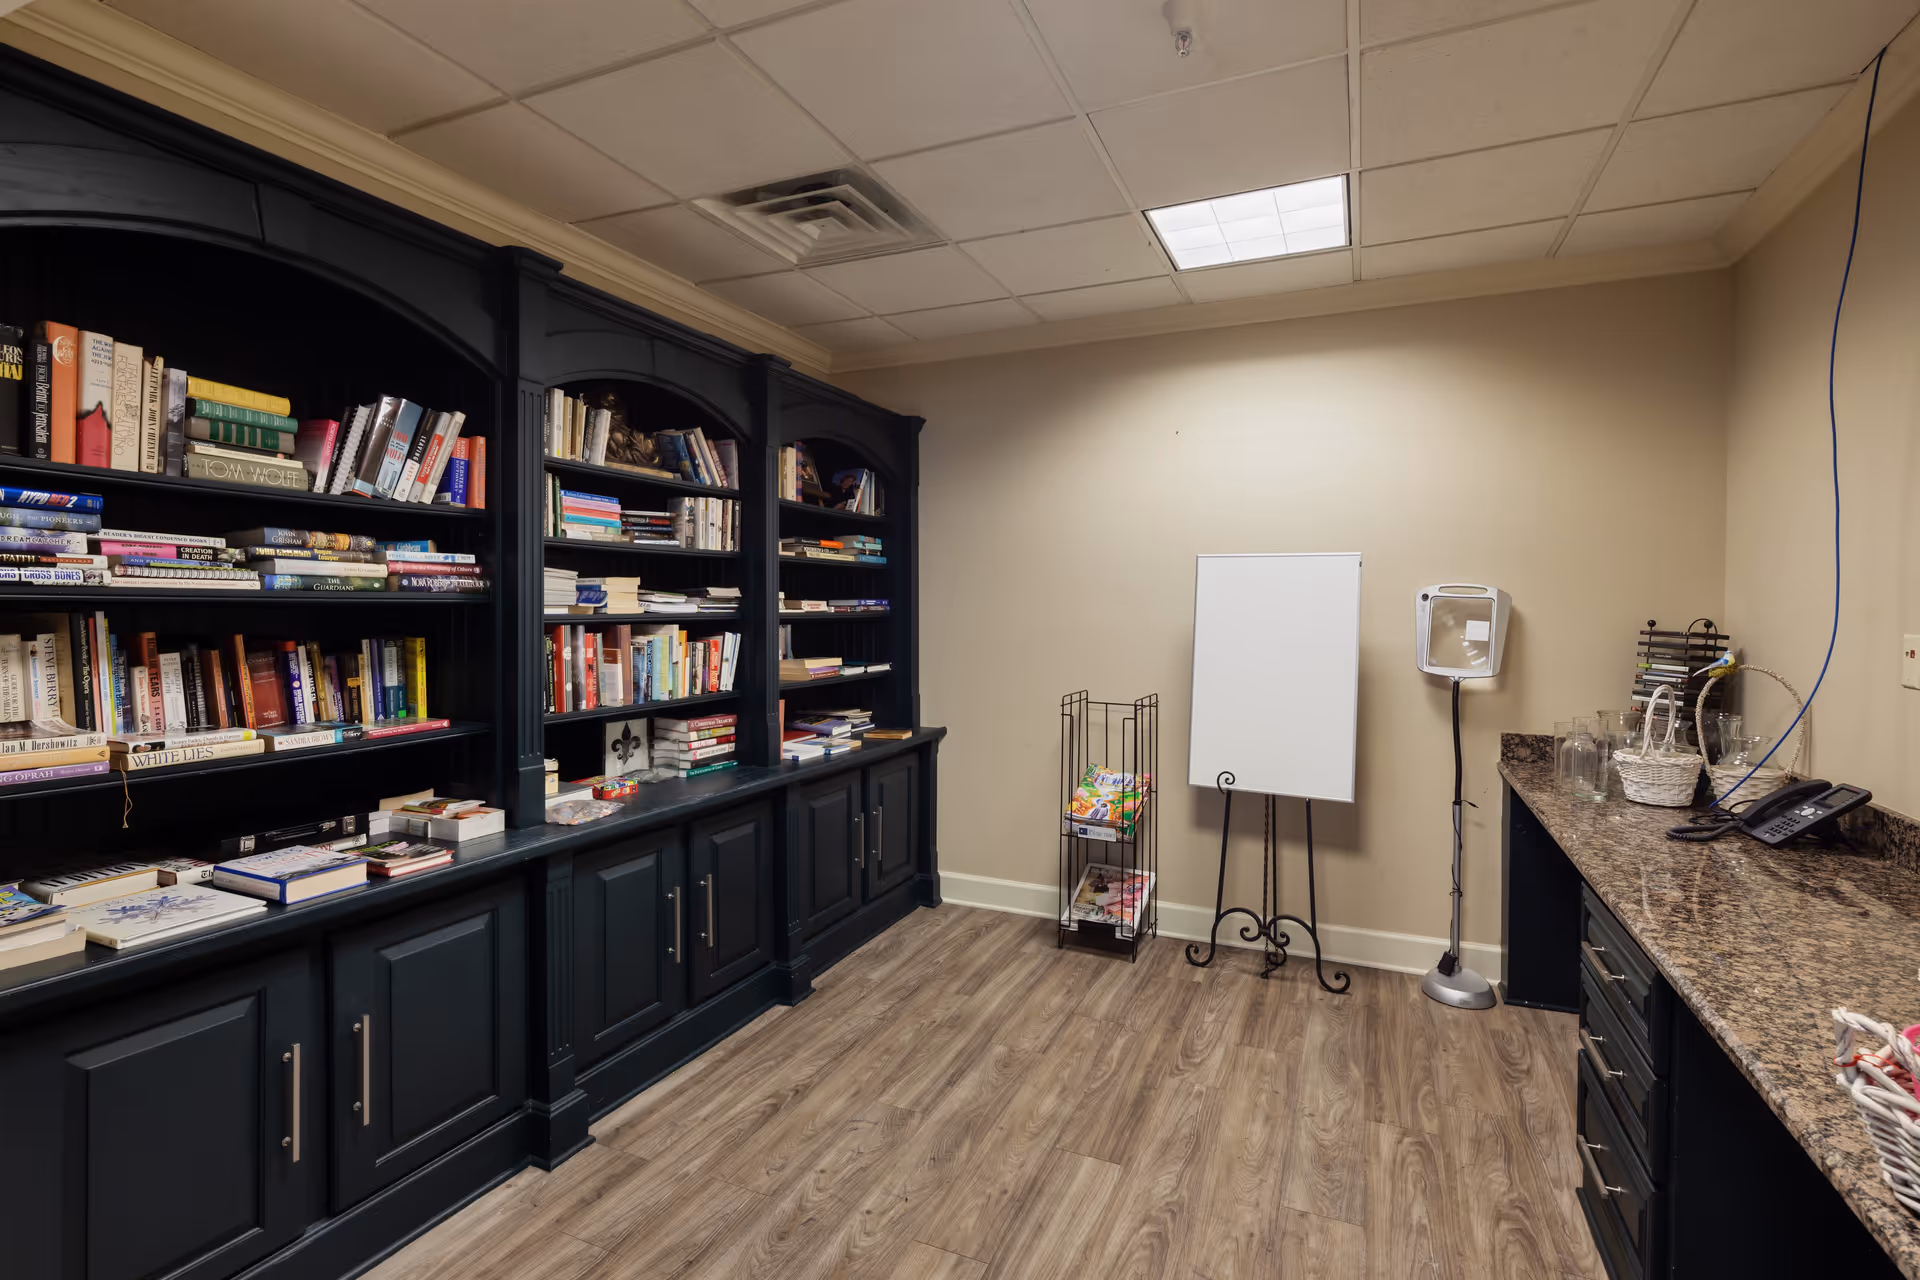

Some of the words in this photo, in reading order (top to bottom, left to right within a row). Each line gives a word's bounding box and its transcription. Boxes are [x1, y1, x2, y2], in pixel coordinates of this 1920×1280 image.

[116, 355, 128, 405] FOLKTALES
[114, 409, 126, 456] CALVINO
[413, 435, 427, 461] LEAVING
[201, 459, 245, 480] TOM
[250, 466, 299, 488] WOLFE
[17, 490, 50, 505] NYPD
[65, 496, 78, 508] 2
[41, 516, 83, 524] PIONEERS
[272, 535, 302, 545] GRISHAM
[278, 529, 296, 537] JOHN
[180, 547, 213, 555] CREATION
[24, 569, 52, 580] CROSS
[54, 571, 81, 581] BONES
[313, 583, 354, 591] GUARDIANS
[44, 637, 56, 672] STEVE
[112, 657, 121, 686] Origins
[46, 673, 58, 708] BERRY
[81, 676, 91, 694] Opera
[149, 672, 161, 698] TEARS
[115, 694, 123, 718] Britain
[0, 742, 16, 754] lan
[19, 741, 29, 752] M.
[31, 738, 78, 751] Dershowitz
[285, 735, 311, 746] SANDRA
[311, 733, 334, 743] BROWN
[132, 751, 180, 768] WHITE
[183, 746, 214, 761] LIES
[15, 771, 54, 782] OPRAH
